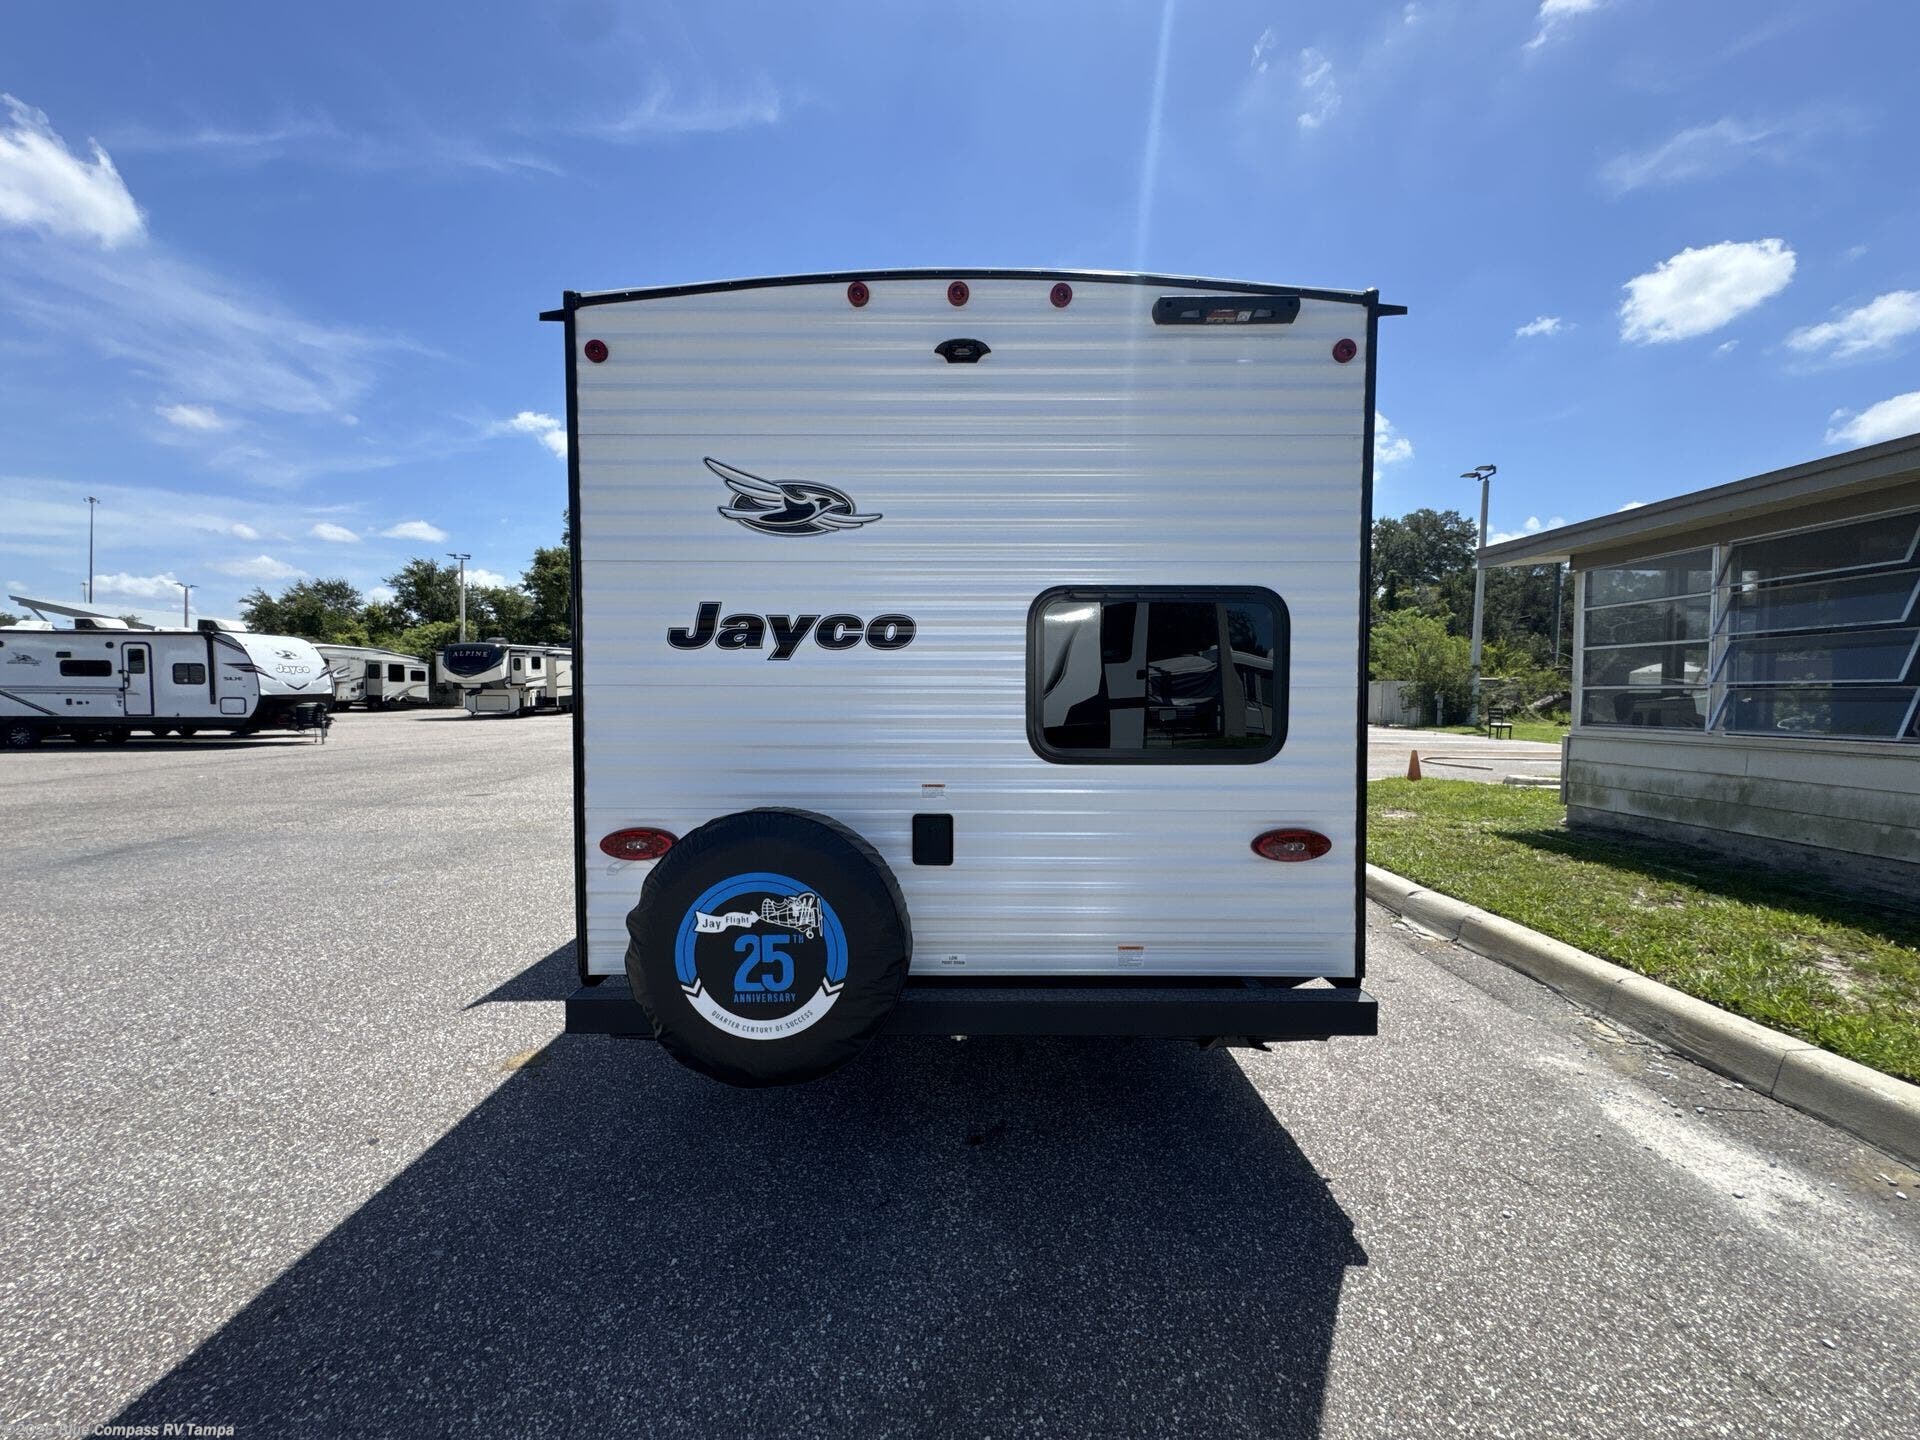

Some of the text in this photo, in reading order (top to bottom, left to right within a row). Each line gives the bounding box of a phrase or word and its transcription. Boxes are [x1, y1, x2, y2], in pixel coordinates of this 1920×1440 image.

[667, 602, 917, 661] Jayco
[276, 664, 310, 674] Jayco
[702, 916, 750, 930] Jay Flight
[734, 993, 796, 1004] ANNIVERSARY
[711, 1009, 814, 1033] QUARTER CENTURY OF SUCCESS
